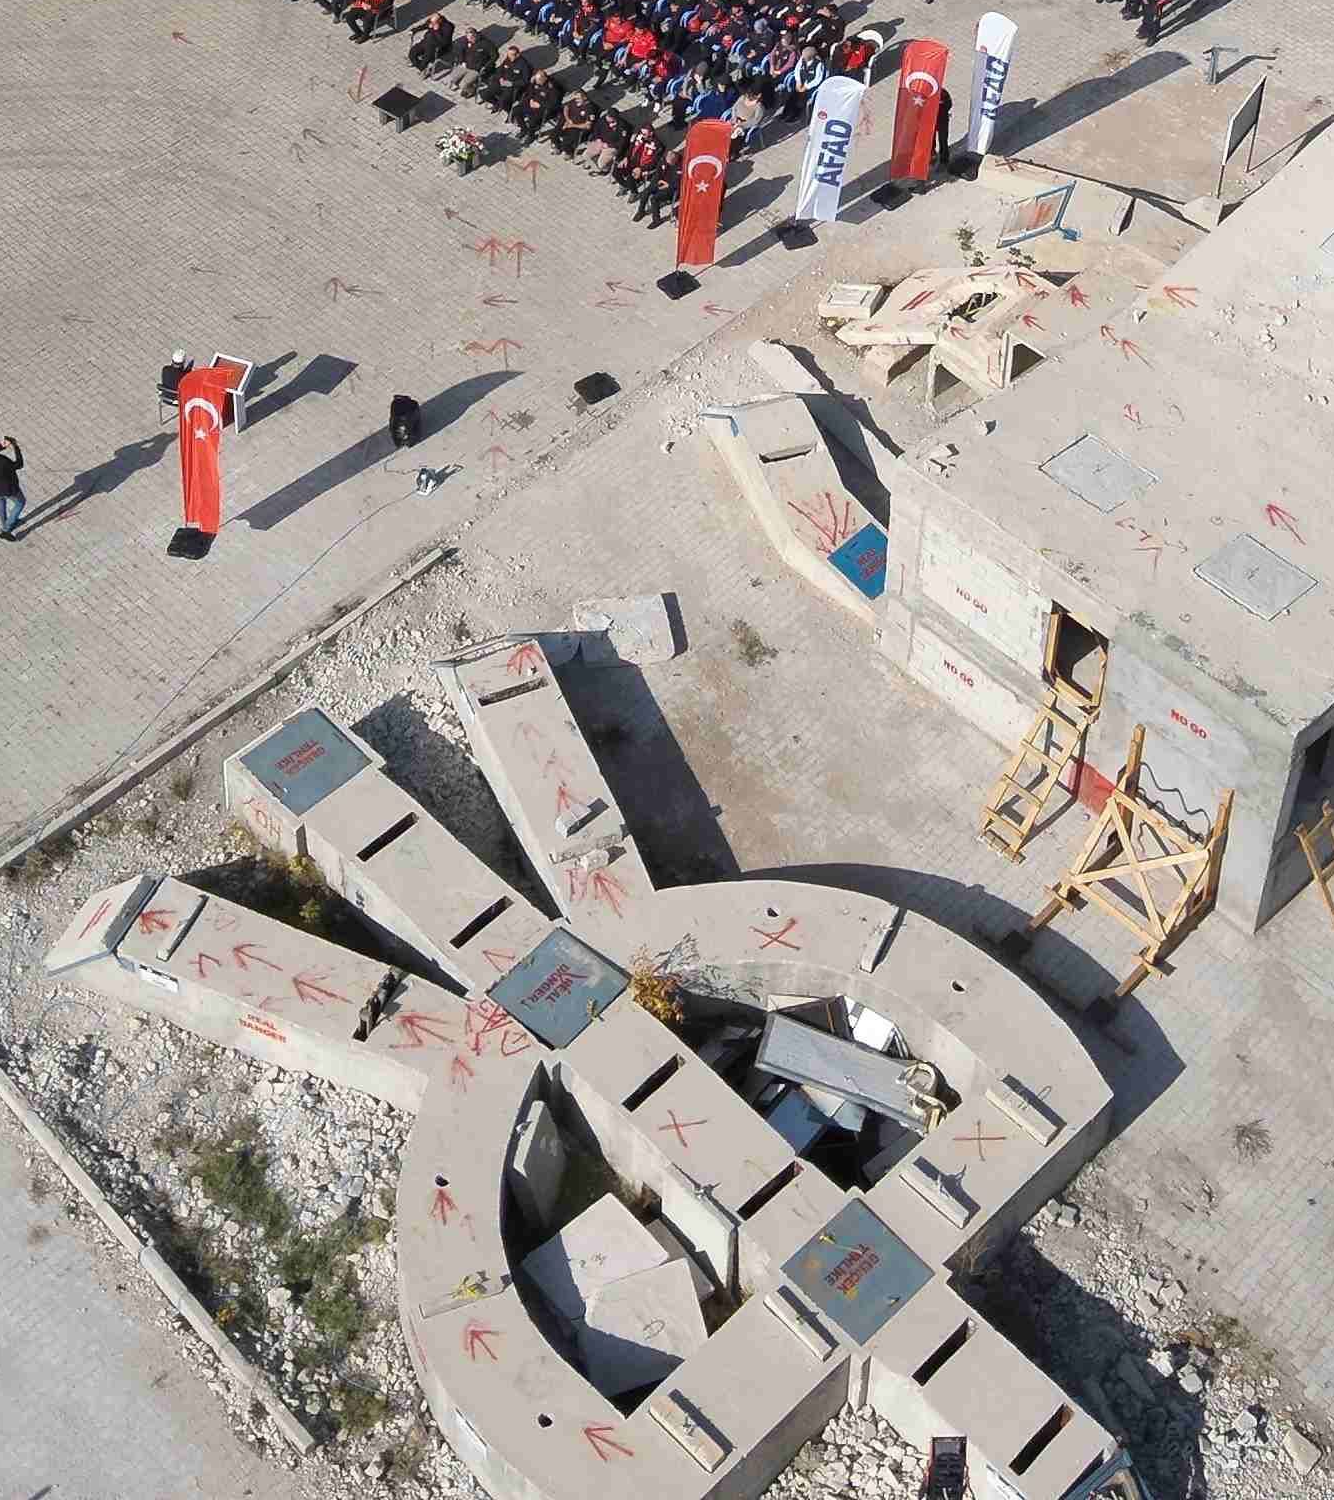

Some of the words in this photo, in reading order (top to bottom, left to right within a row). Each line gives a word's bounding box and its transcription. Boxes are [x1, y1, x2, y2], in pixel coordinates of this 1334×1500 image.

[815, 119, 853, 187] AFAD
[1170, 708, 1187, 726] NO
[1190, 723, 1207, 739] GO
